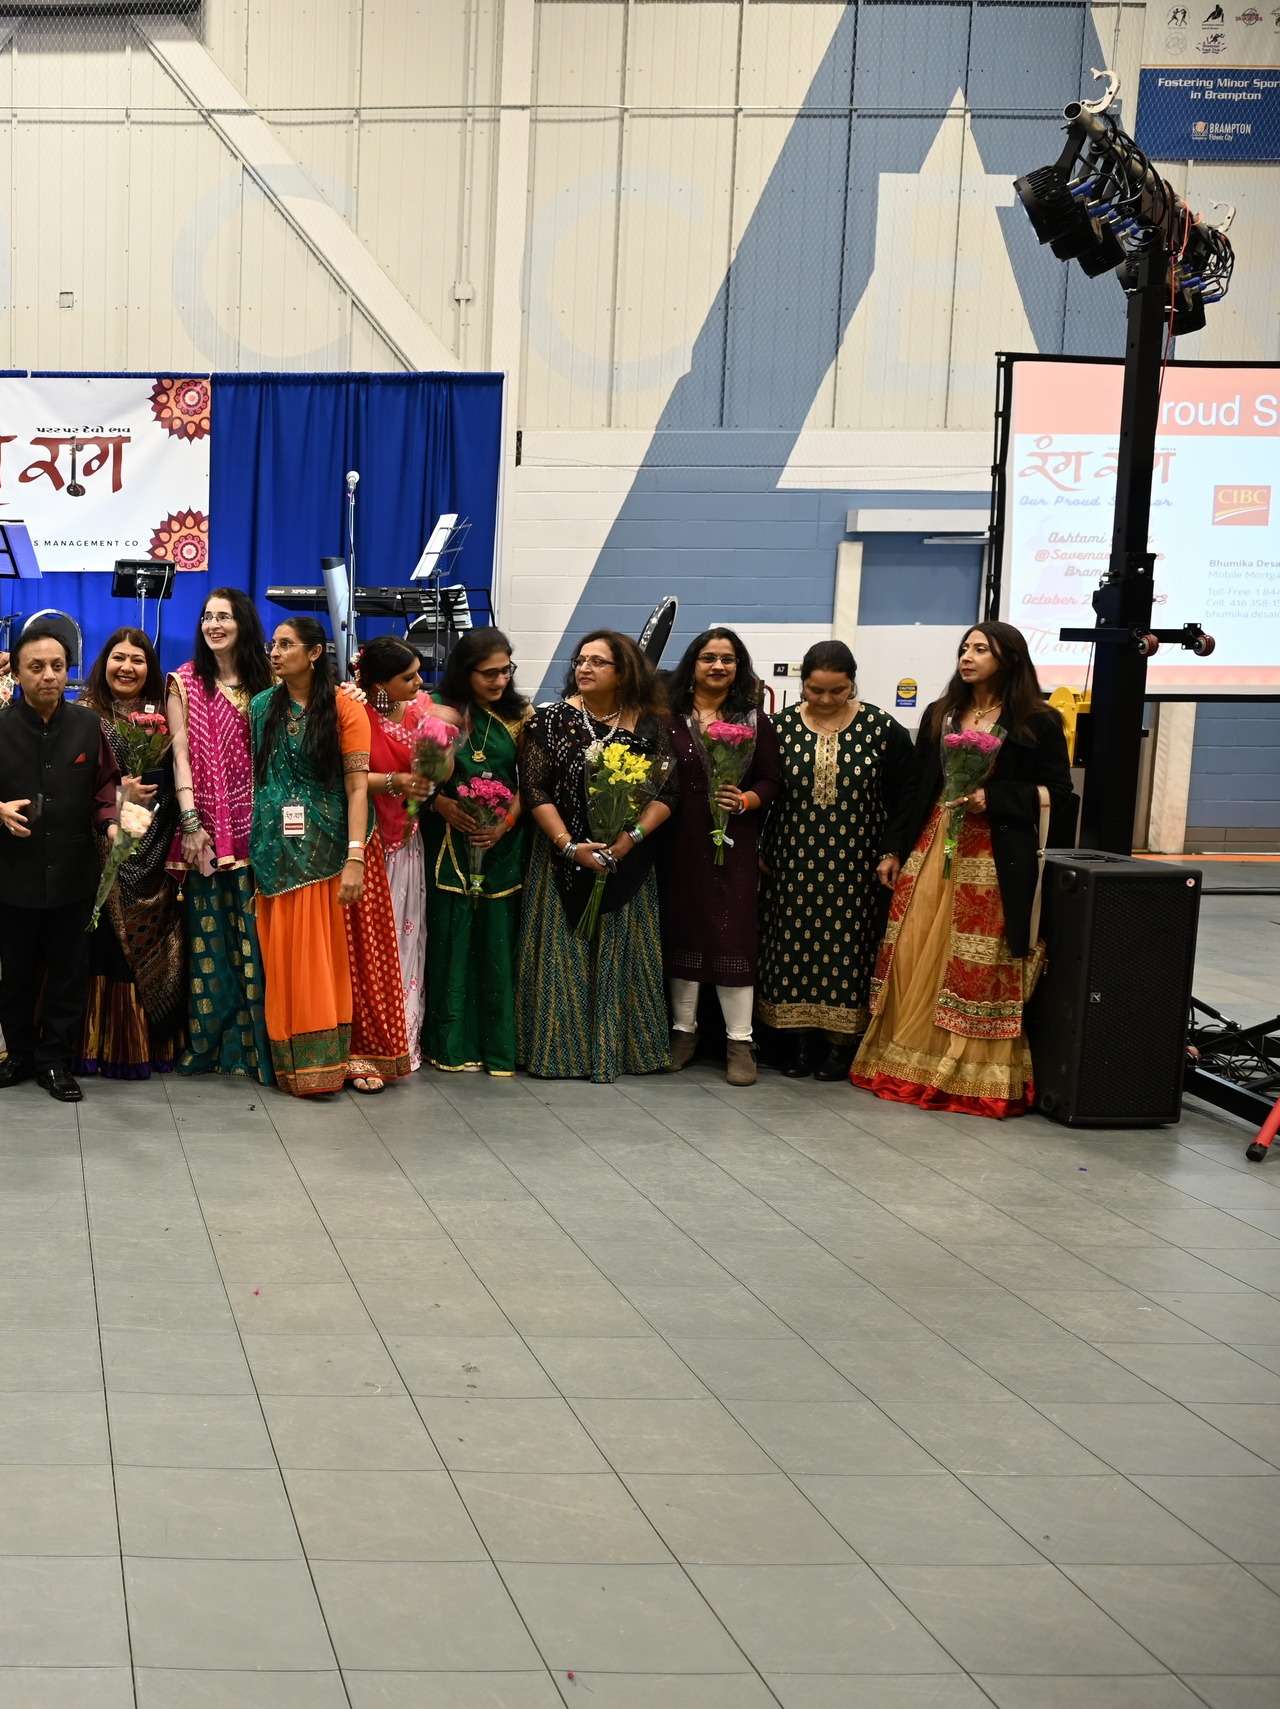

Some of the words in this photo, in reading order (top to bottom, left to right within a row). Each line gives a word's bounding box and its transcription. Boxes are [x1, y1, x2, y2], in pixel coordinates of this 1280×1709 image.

[1158, 78, 1214, 89] Fostering
[1216, 79, 1250, 88] Minor
[1190, 90, 1201, 99] in
[1204, 91, 1261, 101] Brampton
[1209, 122, 1252, 135] BRAMPTON
[1162, 394, 1241, 427] roud
[1217, 489, 1267, 504] CIBC
